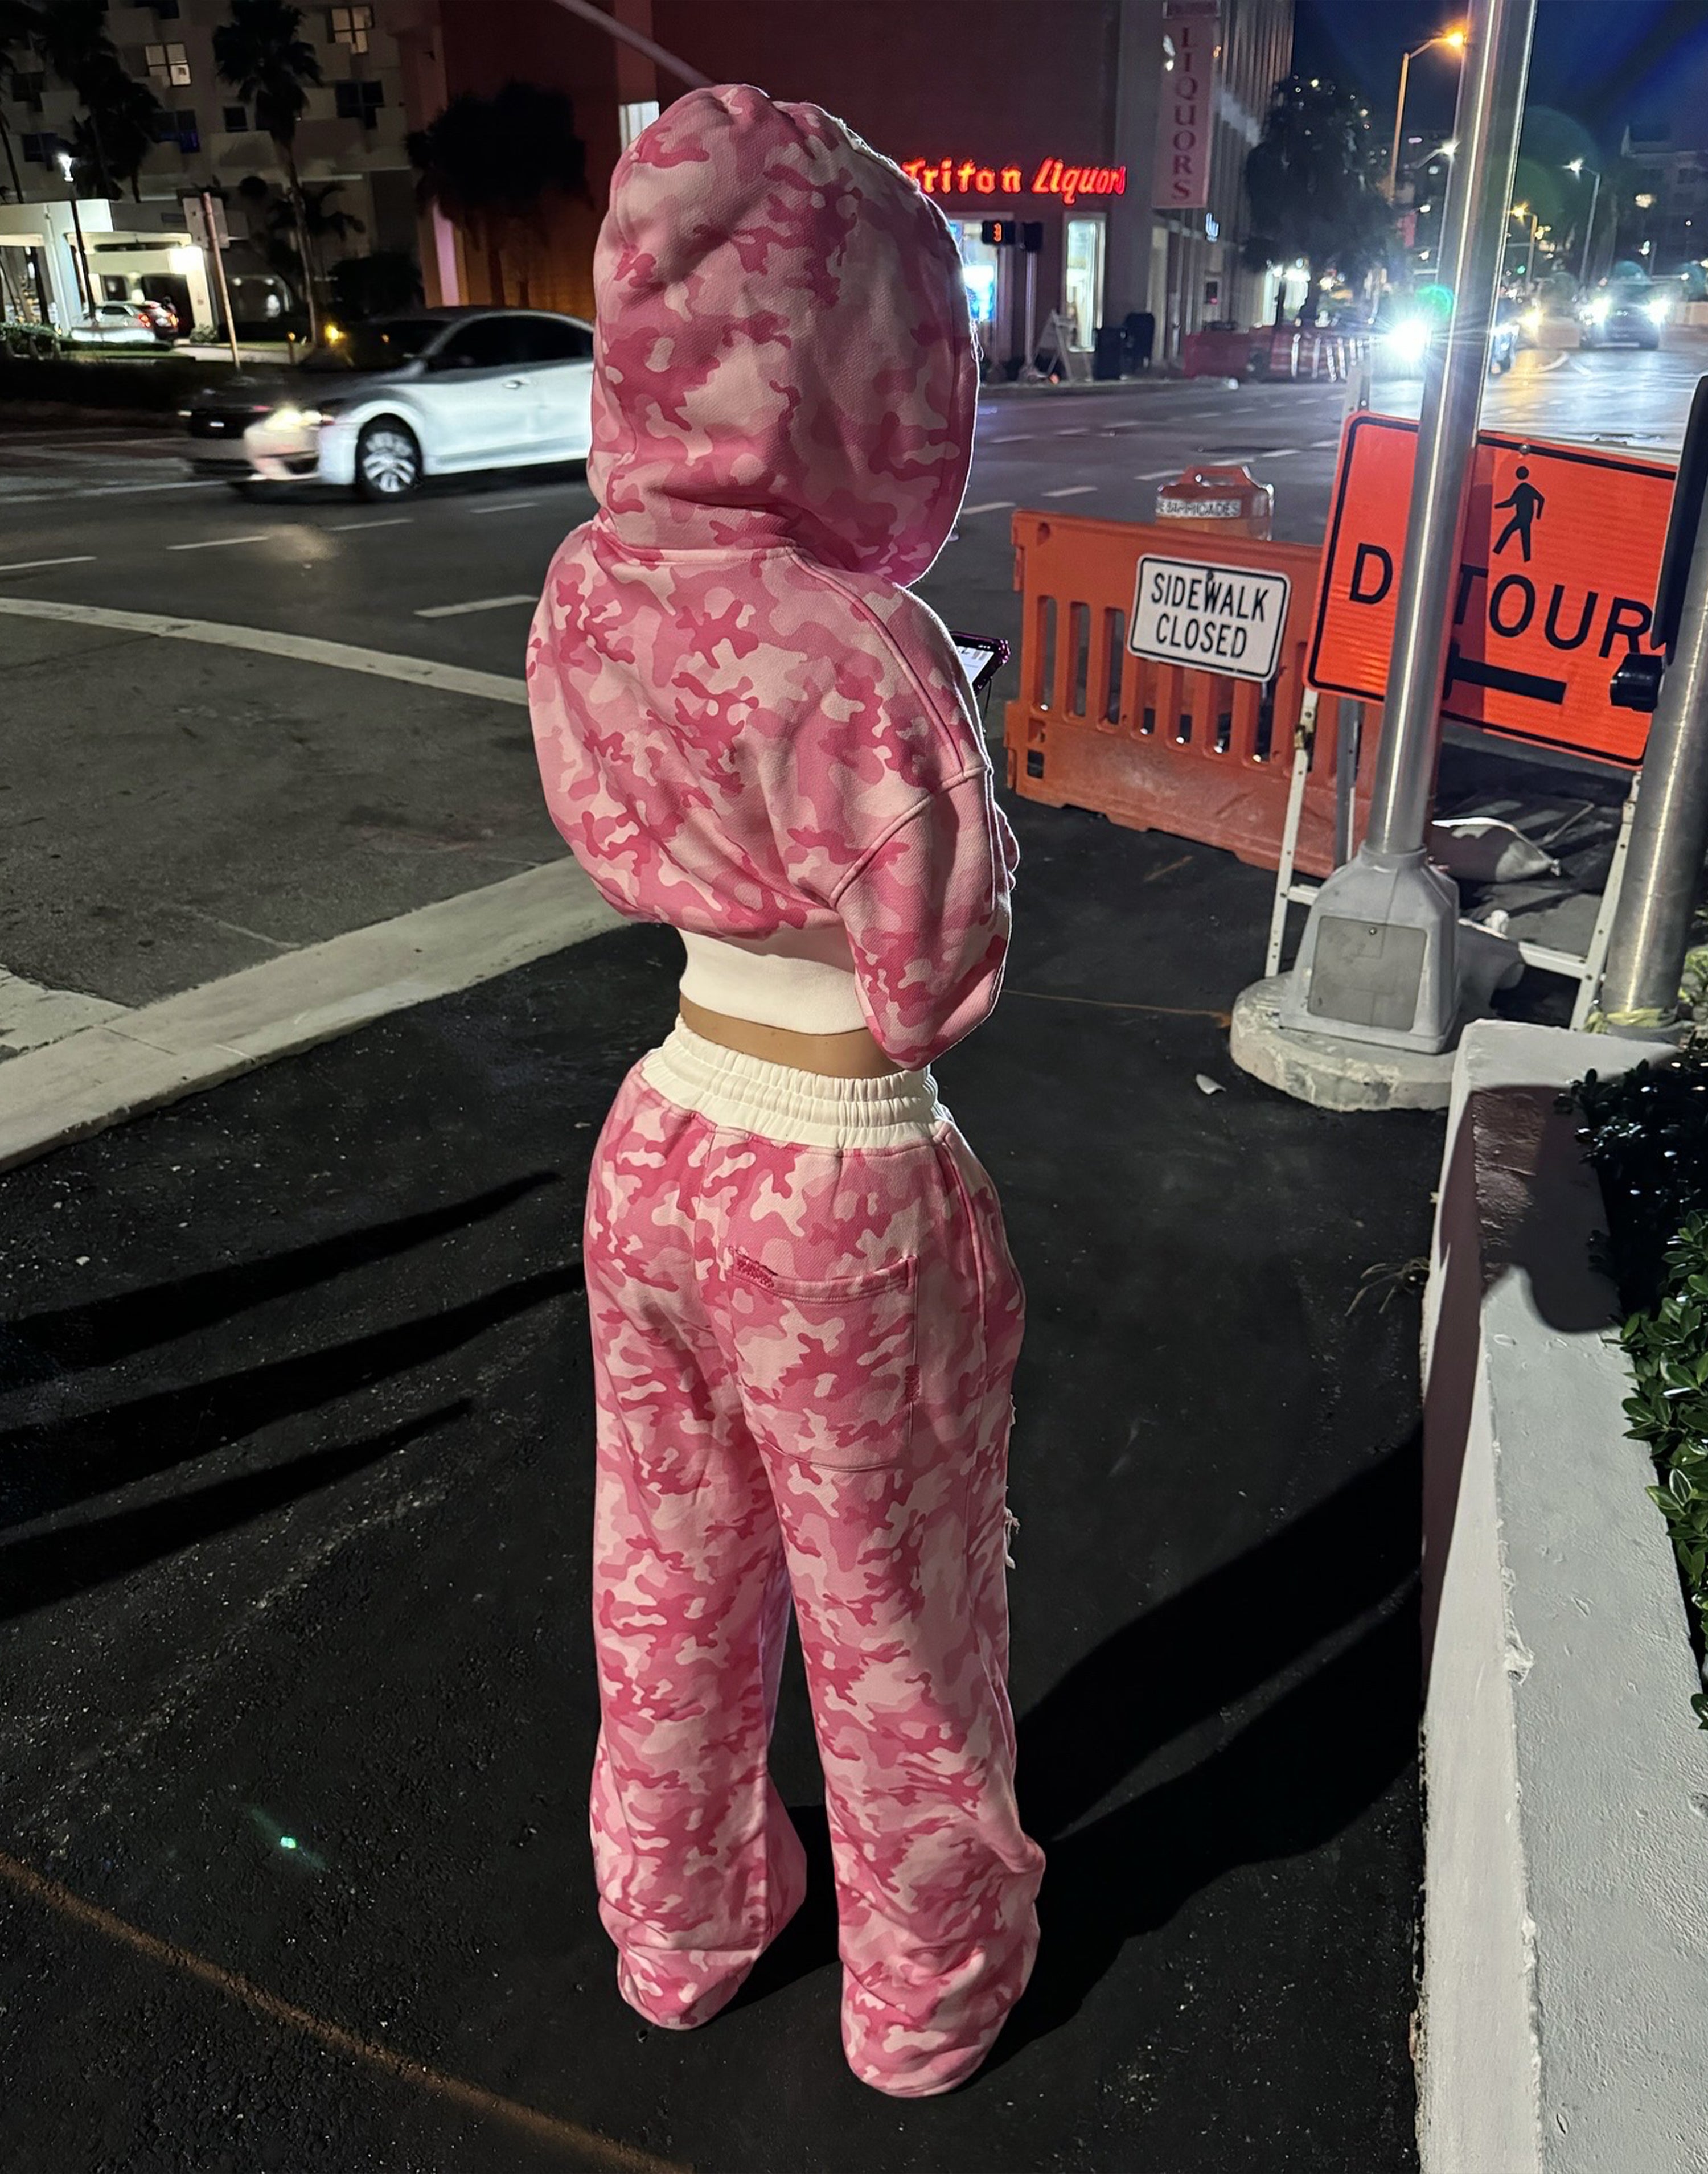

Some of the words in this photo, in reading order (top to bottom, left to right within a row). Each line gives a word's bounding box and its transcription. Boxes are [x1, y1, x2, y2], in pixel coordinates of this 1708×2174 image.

[1173, 27, 1198, 200] LIQUORS
[902, 157, 1022, 194] Triton
[993, 223, 1001, 242] 3
[1151, 572, 1268, 623] SIDEWALK
[1349, 543, 1653, 658] DTOUR
[1156, 613, 1247, 659] CLOSED
